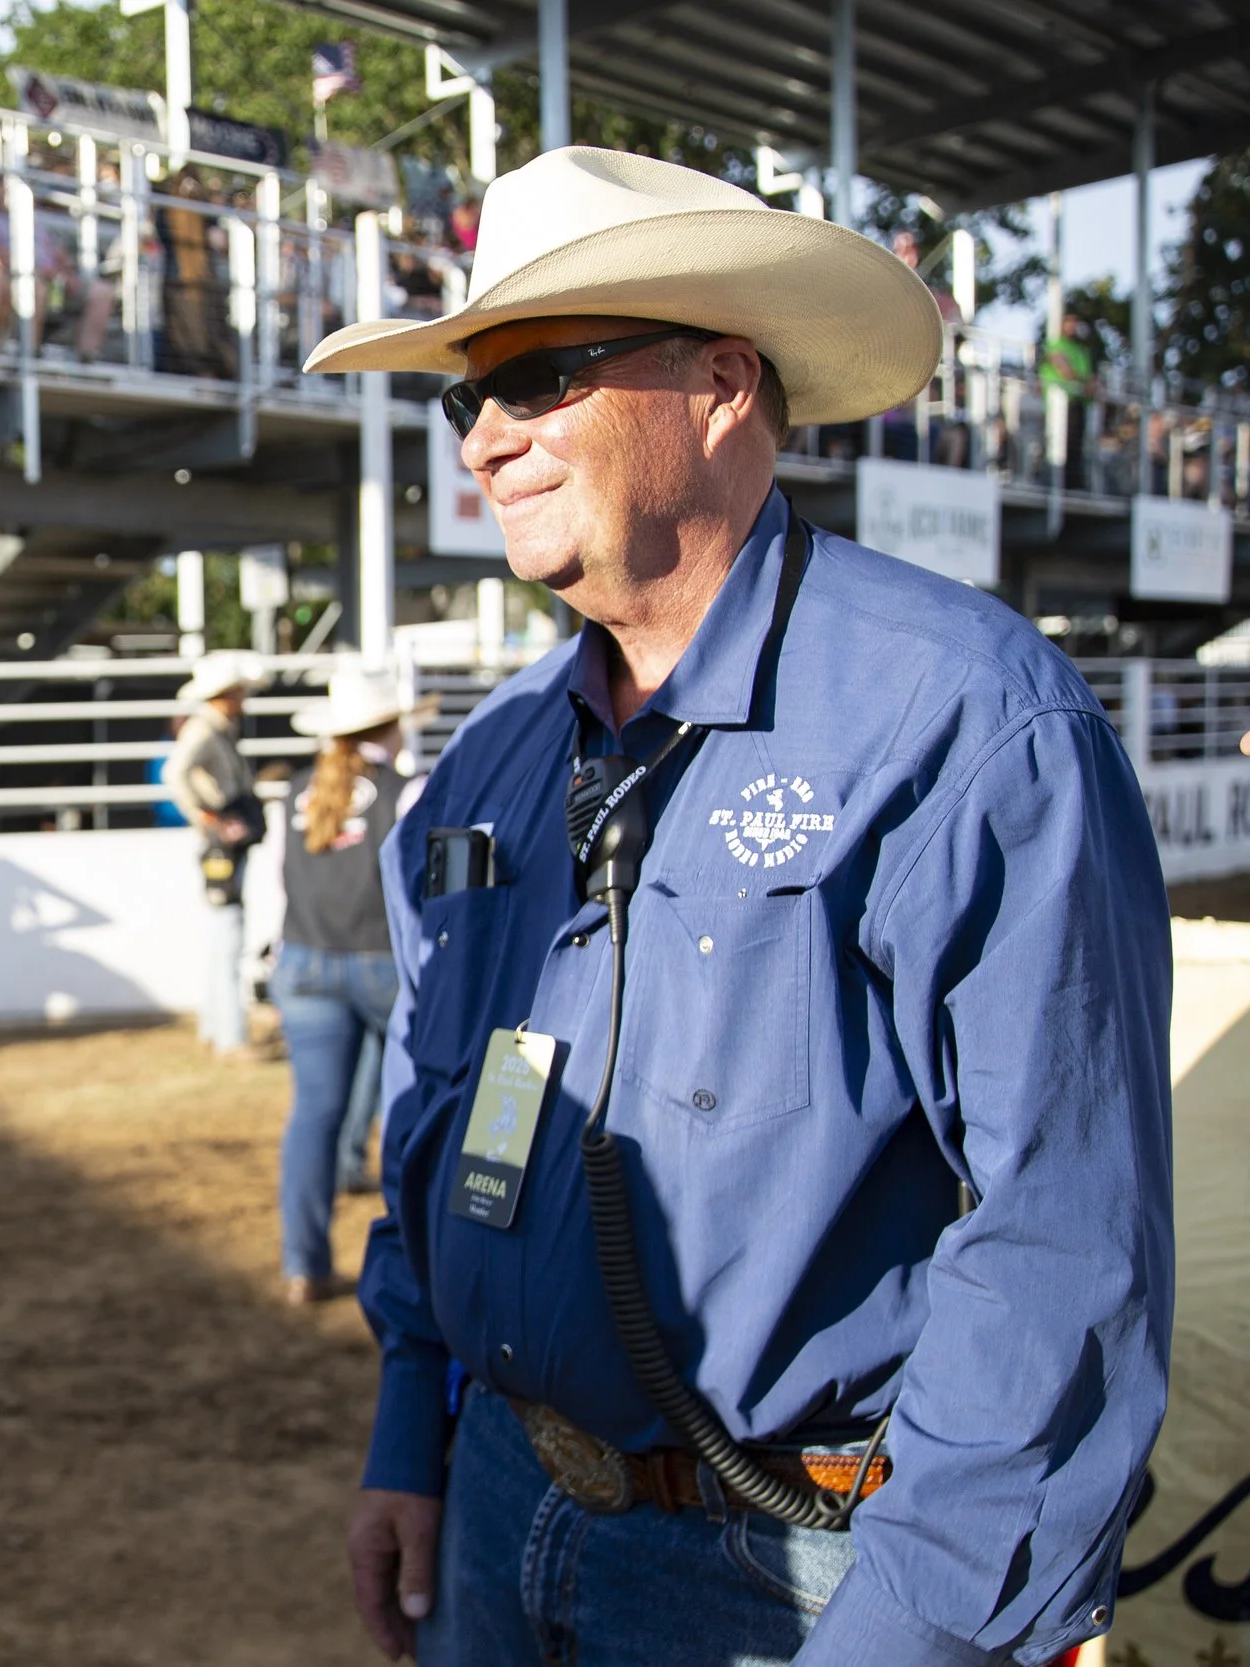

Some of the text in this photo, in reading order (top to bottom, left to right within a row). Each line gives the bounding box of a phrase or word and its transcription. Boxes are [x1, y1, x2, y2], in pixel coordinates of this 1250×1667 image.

[587, 807, 609, 843] PAUL
[605, 765, 647, 808] RODEO
[708, 809, 834, 831] ST. PAUL FIRE
[464, 1171, 506, 1199] ARENA
